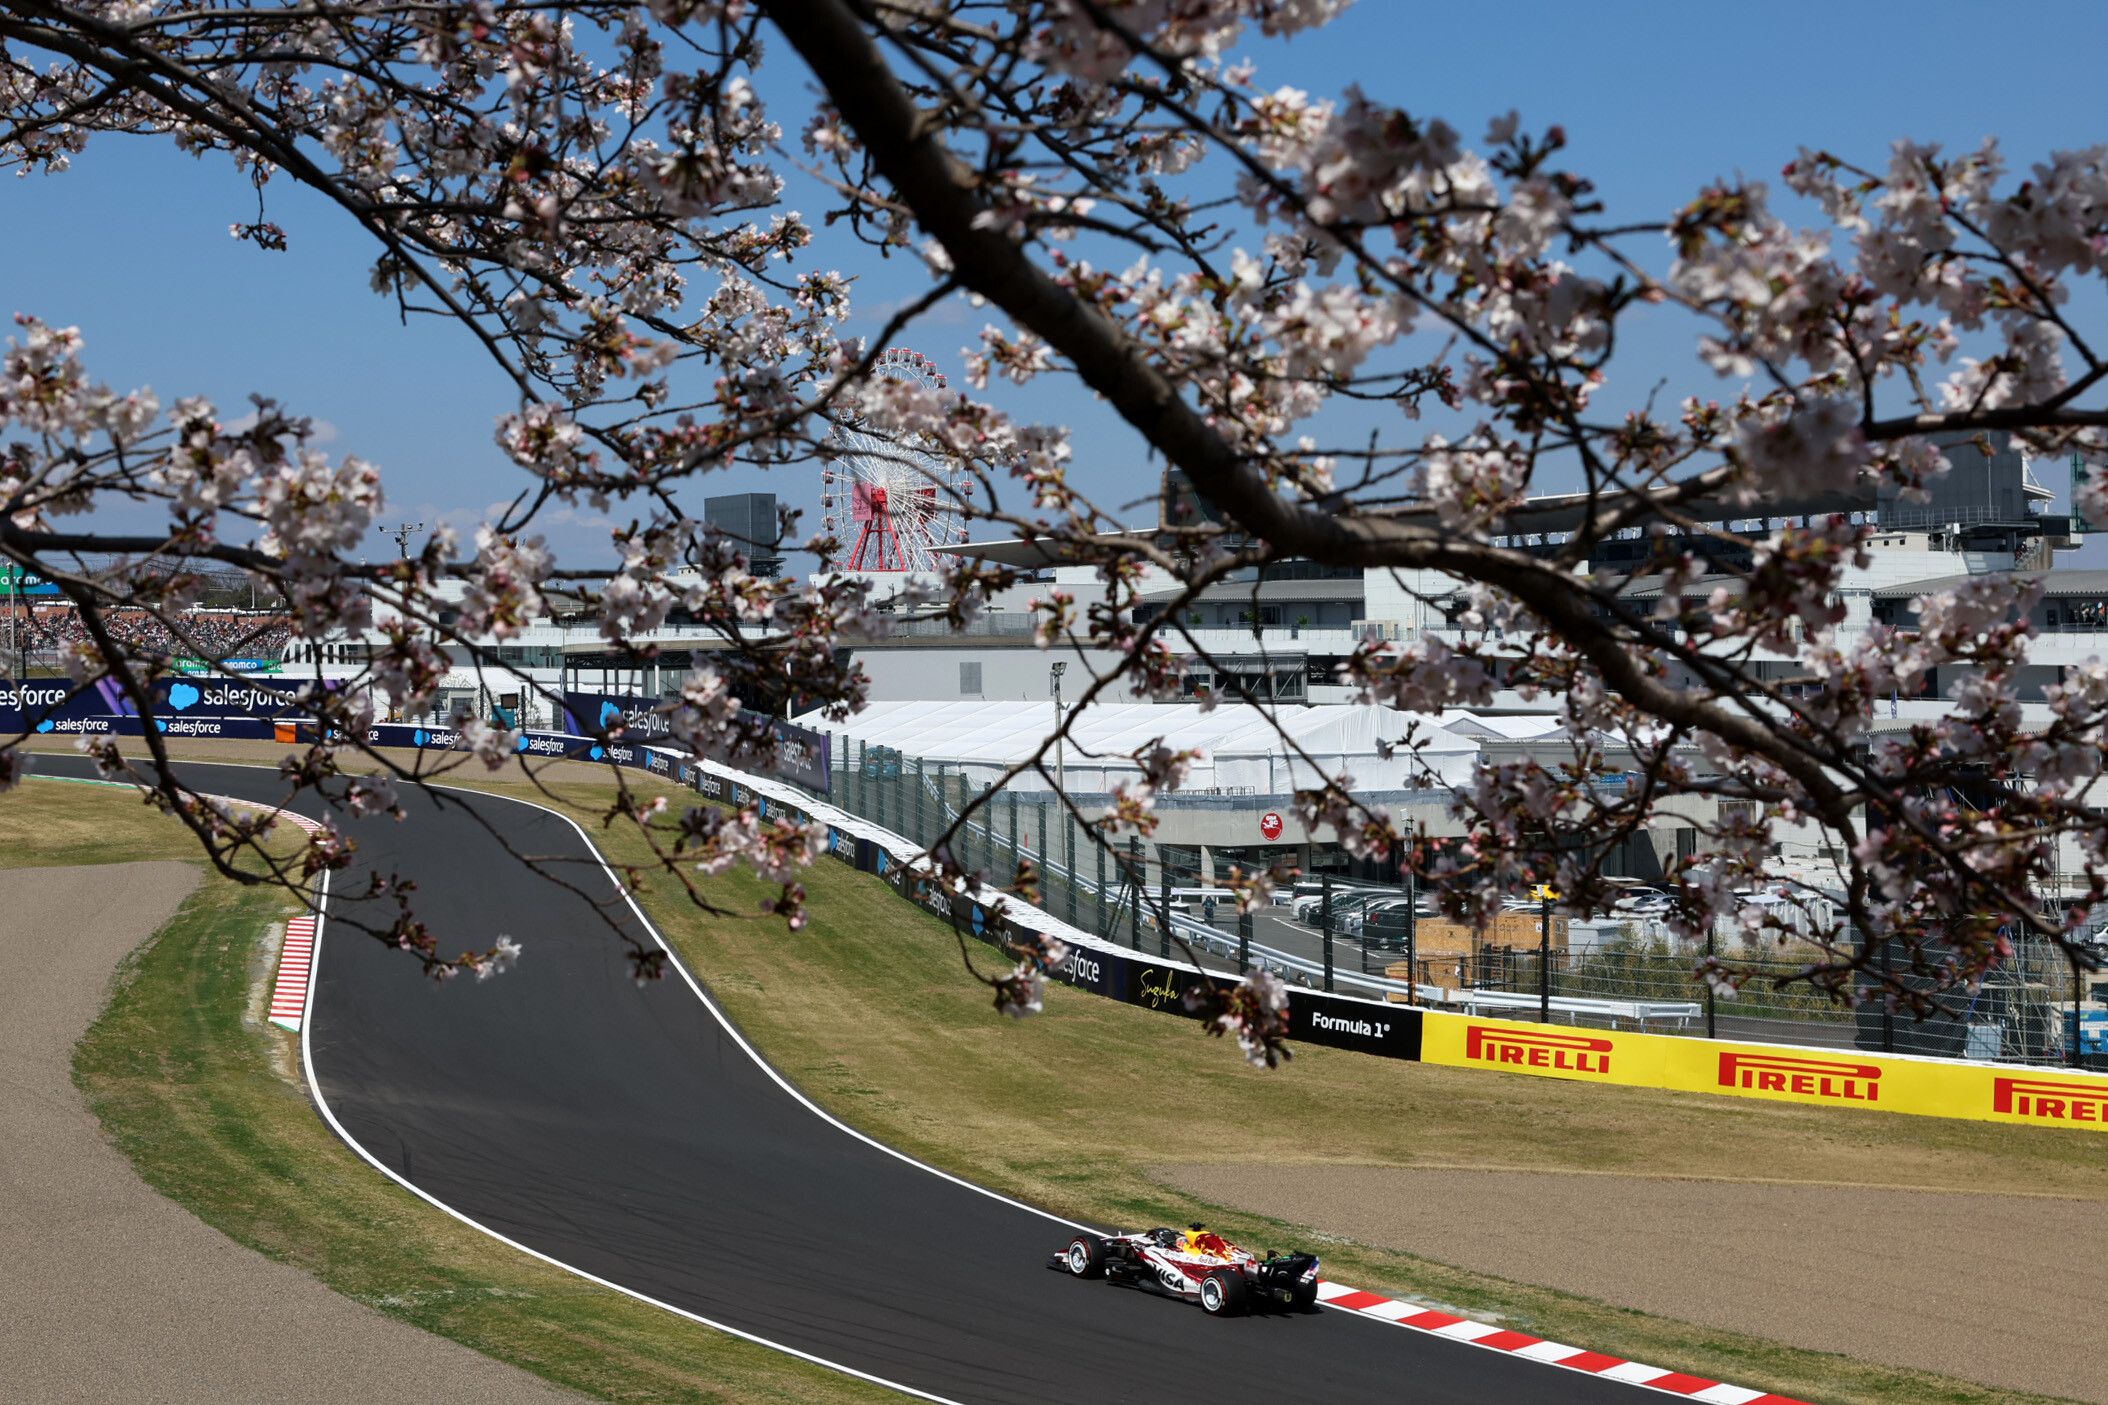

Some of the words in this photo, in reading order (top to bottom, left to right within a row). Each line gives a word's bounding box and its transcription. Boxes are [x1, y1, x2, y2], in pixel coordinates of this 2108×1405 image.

[55, 718, 109, 733] salesforce
[168, 720, 221, 736] salesforce
[529, 737, 564, 756] salesforce
[1140, 969, 1179, 1007] Suzuka
[1312, 1011, 1372, 1036] Formula
[1466, 1025, 1613, 1074] PIRELLI
[1718, 1052, 1882, 1101] PIRELLI
[1153, 1262, 1185, 1292] VISA
